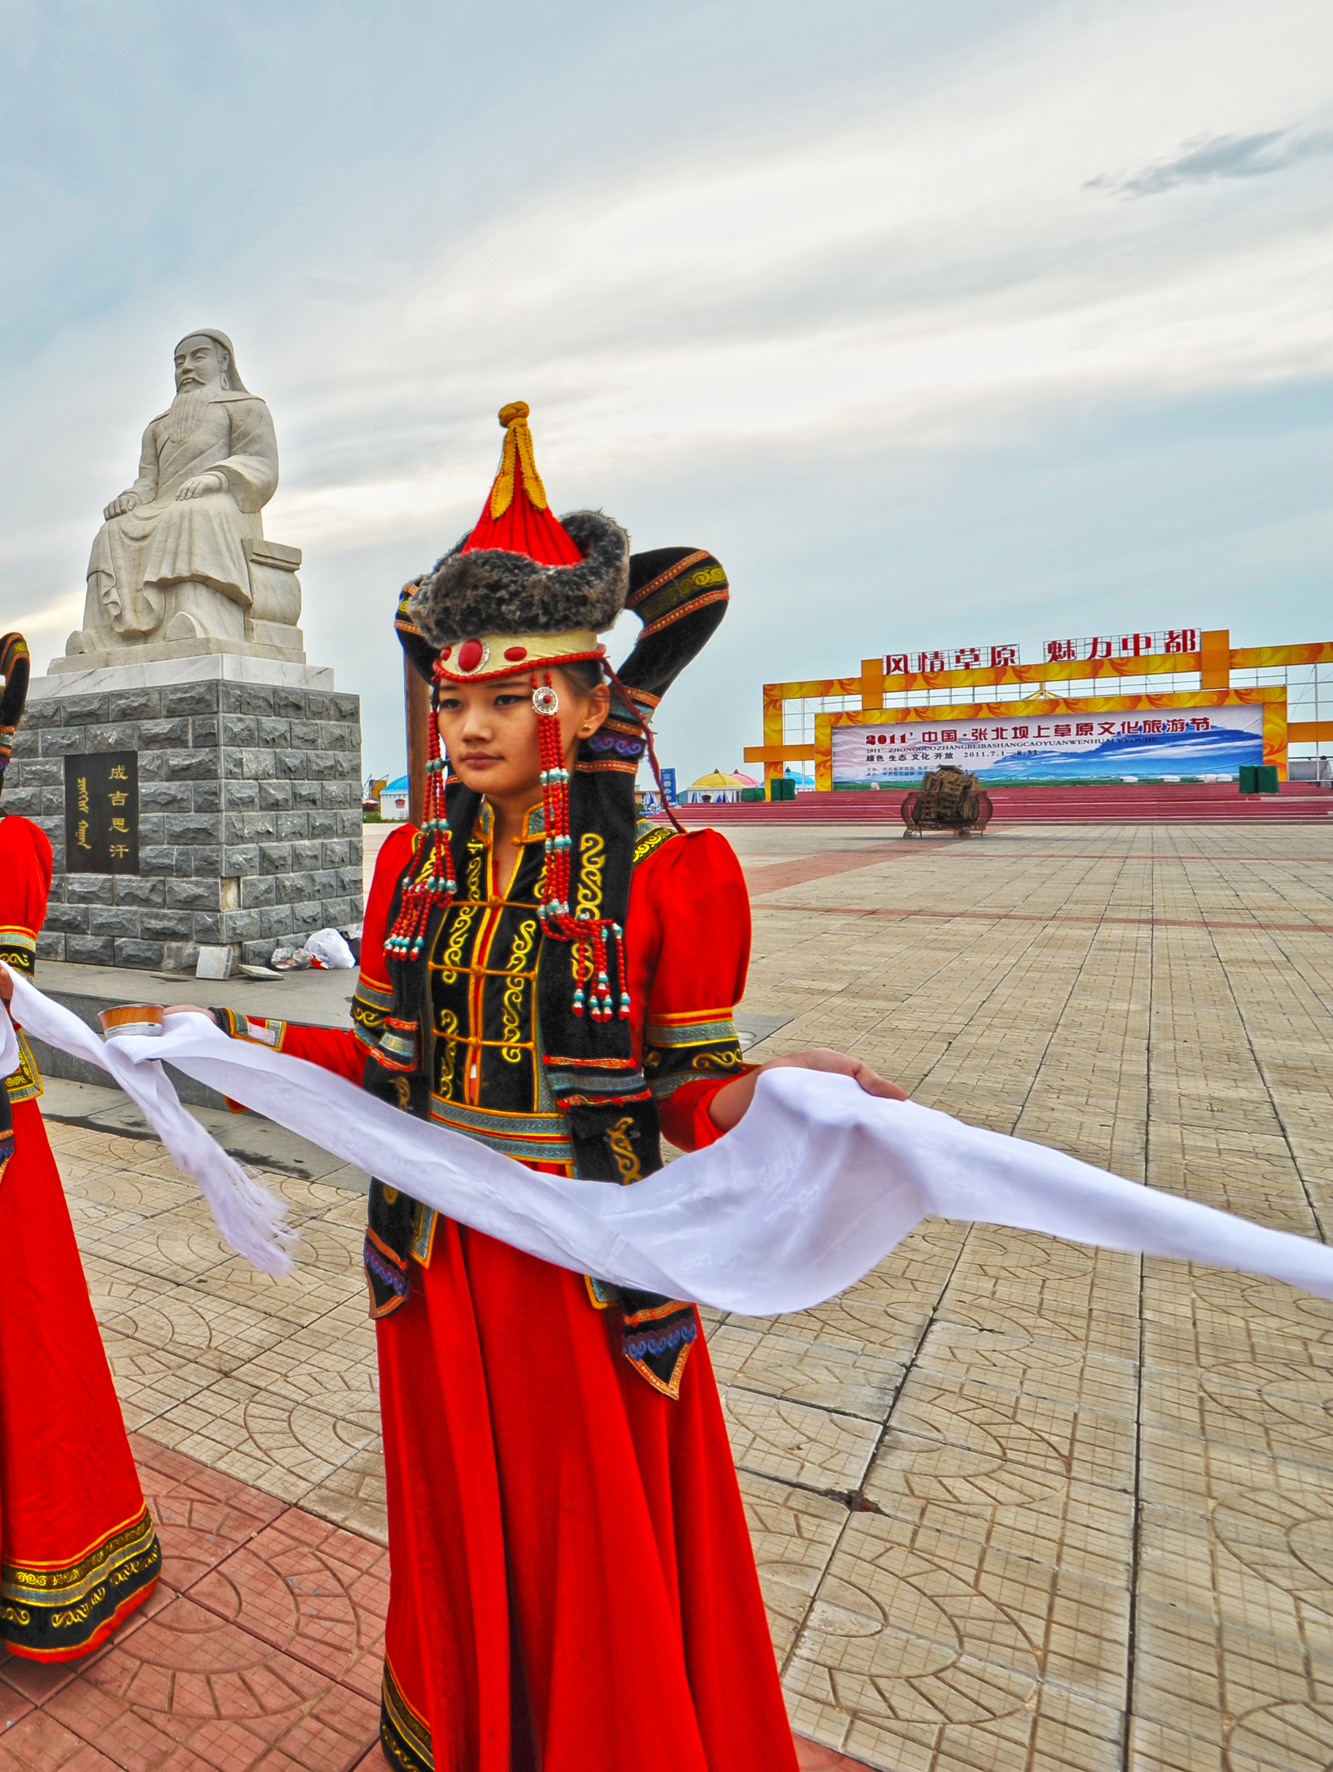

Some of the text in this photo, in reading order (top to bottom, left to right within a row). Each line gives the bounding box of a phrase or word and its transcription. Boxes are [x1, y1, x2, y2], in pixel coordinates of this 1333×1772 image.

[885, 628, 1197, 676] 风情草原 魅力中都
[866, 754, 885, 762] 绿色
[888, 754, 907, 762] 生态
[911, 752, 930, 761] 文化
[934, 751, 954, 760] 开放
[108, 764, 130, 858] 成吉思汗
